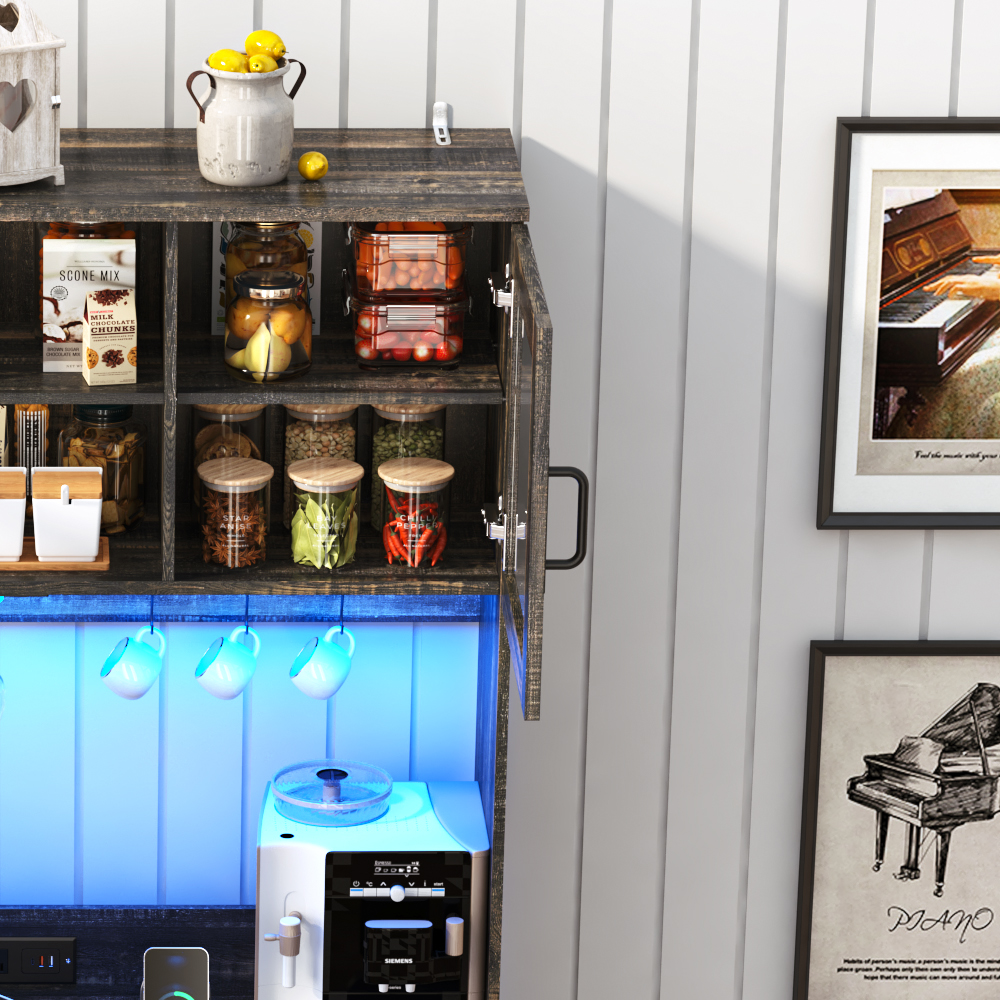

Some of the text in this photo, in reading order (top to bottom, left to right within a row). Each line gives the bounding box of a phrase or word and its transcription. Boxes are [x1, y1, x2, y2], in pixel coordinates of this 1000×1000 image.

[59, 270, 120, 281] SCONE MIX
[90, 325, 136, 334] CHUNKS
[222, 514, 250, 522] STAR
[219, 522, 253, 530] ANISE
[306, 522, 347, 530] LEAVES
[396, 522, 438, 530] PEPPER
[887, 906, 994, 944] PIANO
